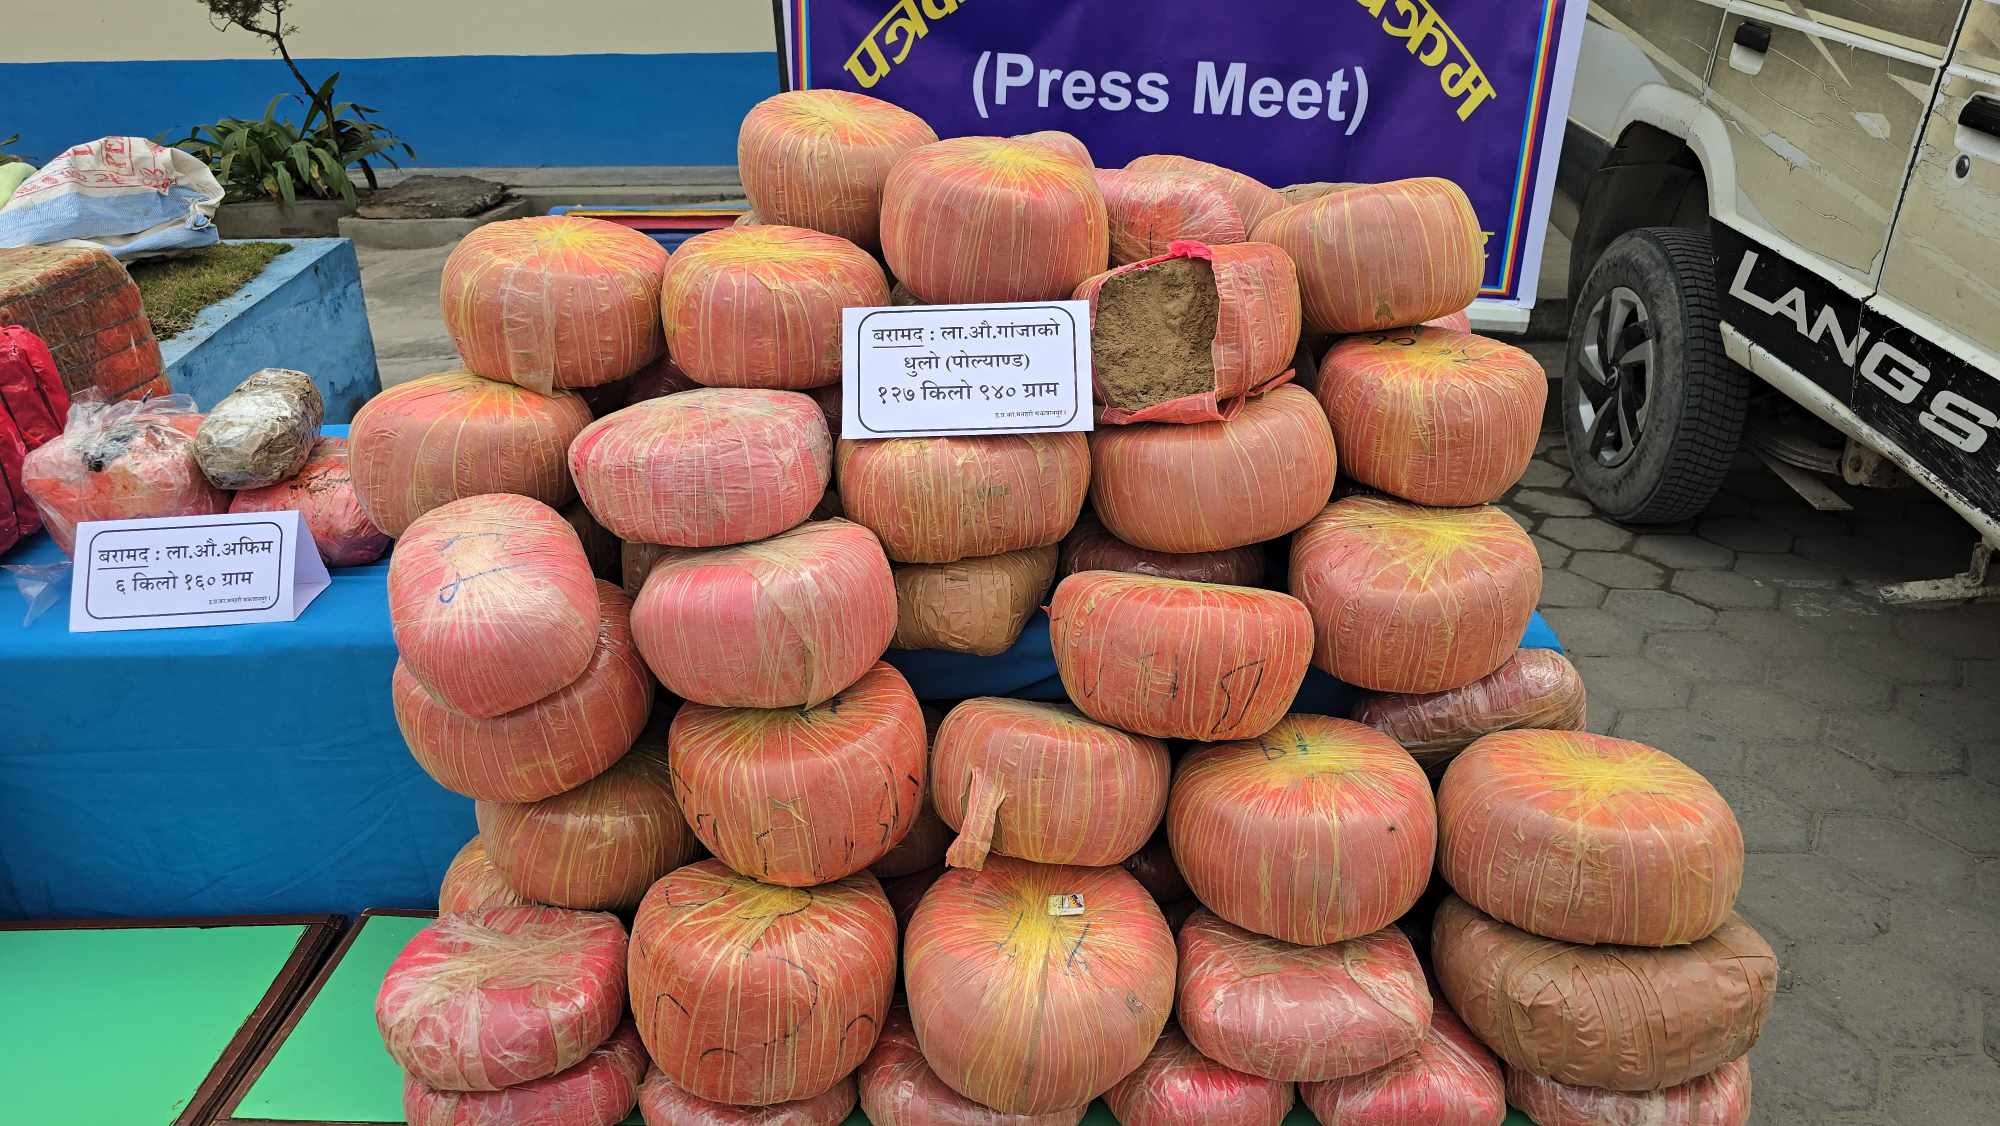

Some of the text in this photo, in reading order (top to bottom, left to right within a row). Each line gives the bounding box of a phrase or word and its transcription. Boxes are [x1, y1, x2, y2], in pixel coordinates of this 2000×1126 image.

[843, 0, 1497, 122] पत्र क्रम
[972, 51, 1369, 135] (Press Meet)
[872, 328, 924, 342] बरामद
[940, 318, 1060, 339] ला.औ.गांजाको
[946, 350, 1029, 371] (पोल्याण्ड)
[1728, 250, 2000, 453] LANGS
[879, 380, 1059, 404] १२७ किलो ९४० ग्राम
[98, 548, 150, 562] बरामद
[166, 536, 273, 559] ला.औ.अफिम
[116, 571, 254, 594] ६ किलो १६० ग्राम
